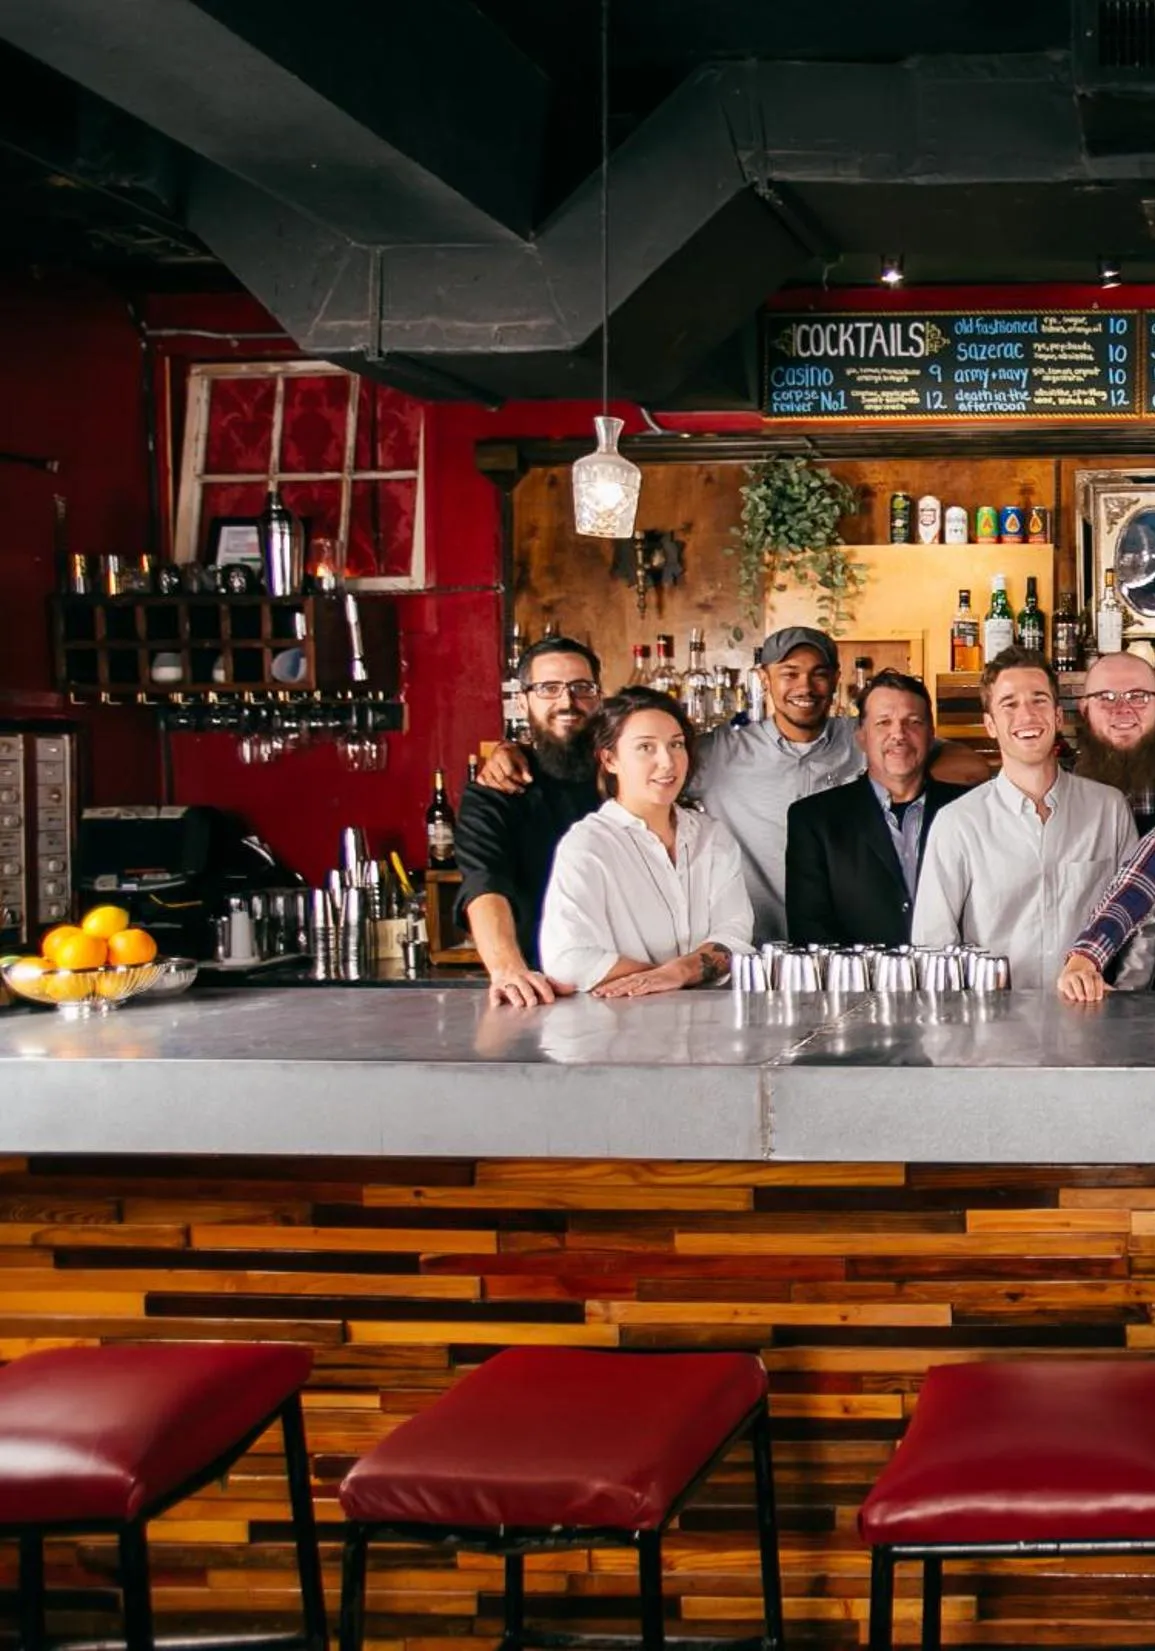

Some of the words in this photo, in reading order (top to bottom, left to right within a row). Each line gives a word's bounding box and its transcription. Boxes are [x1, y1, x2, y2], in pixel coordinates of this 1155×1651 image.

[974, 317, 1038, 335] fashioned
[1109, 318, 1128, 335] 10
[797, 322, 925, 358] COCKTAILS
[1109, 344, 1128, 363] 10
[928, 364, 942, 383] 9
[1109, 368, 1127, 385] 10
[772, 389, 819, 403] corpse
[926, 391, 947, 410] 12
[955, 389, 992, 402] death
[1110, 390, 1130, 407] 12
[772, 401, 814, 412] reviver
[959, 400, 1026, 412] afternoon
